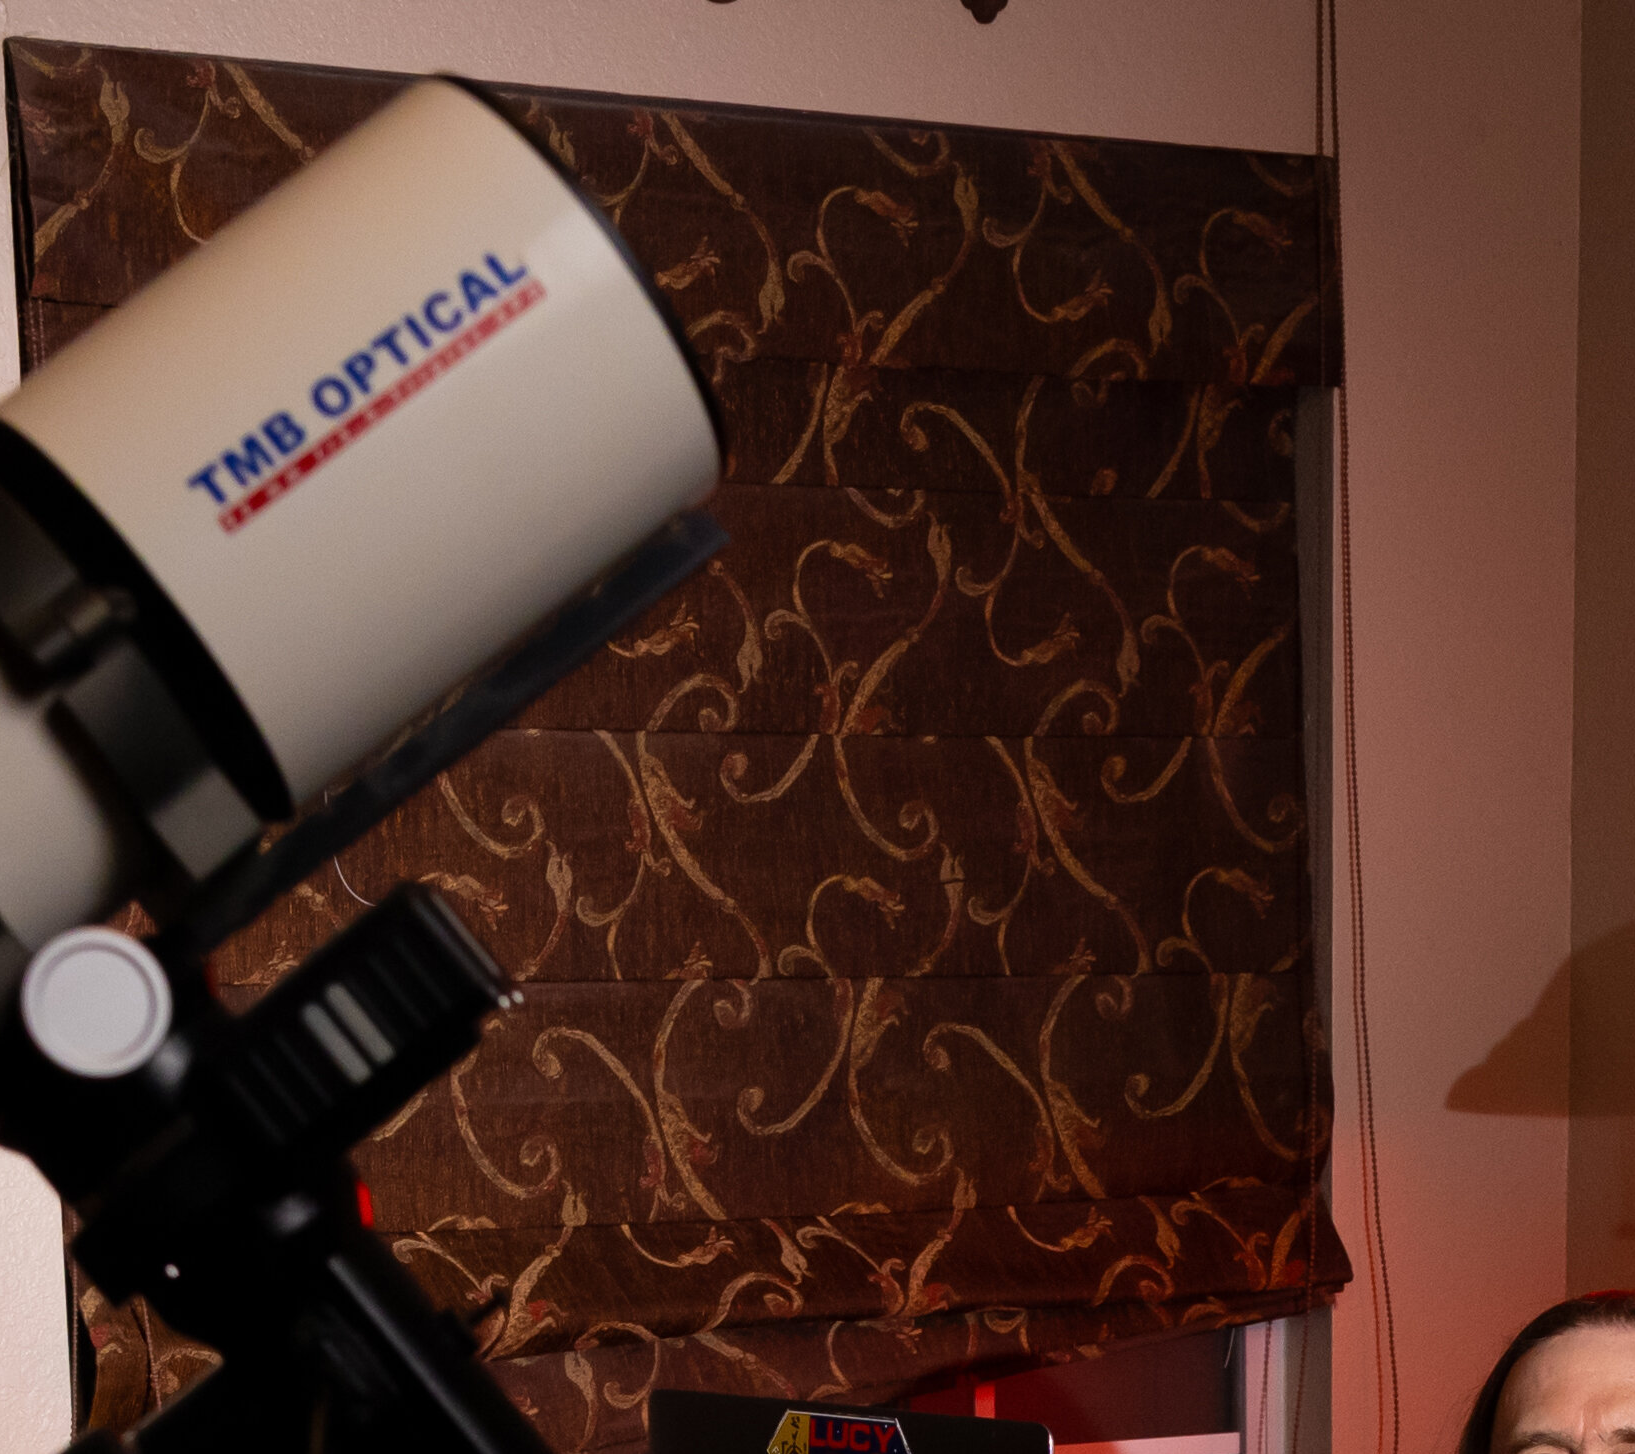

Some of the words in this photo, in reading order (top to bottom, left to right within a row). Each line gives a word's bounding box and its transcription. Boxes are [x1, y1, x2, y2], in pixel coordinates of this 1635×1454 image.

[188, 411, 305, 503] TMB
[310, 253, 528, 418] OPTICAL
[810, 1418, 896, 1454] LUCY
